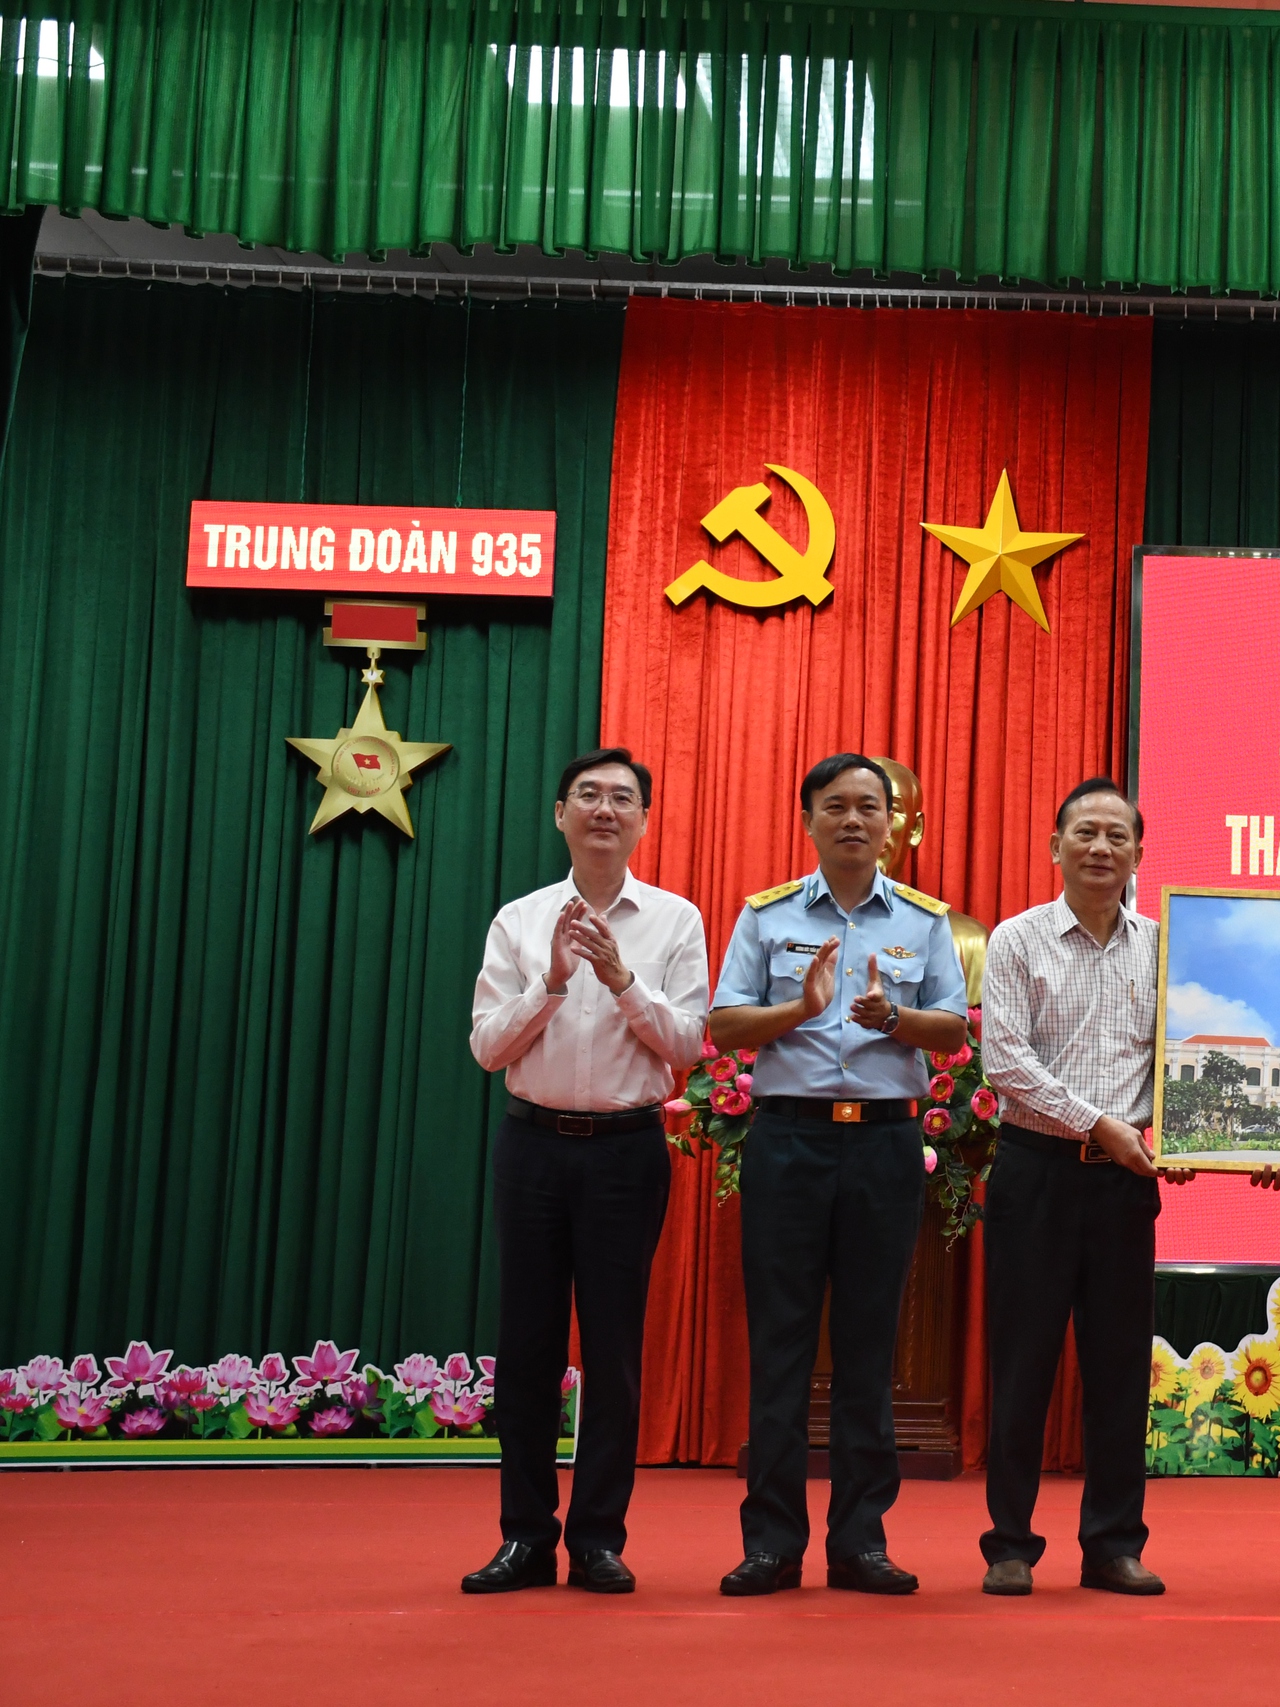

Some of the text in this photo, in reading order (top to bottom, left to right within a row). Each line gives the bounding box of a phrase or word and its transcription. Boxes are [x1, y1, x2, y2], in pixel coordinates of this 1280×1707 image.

[204, 520, 542, 577] TRUNG ĐOÀN 935
